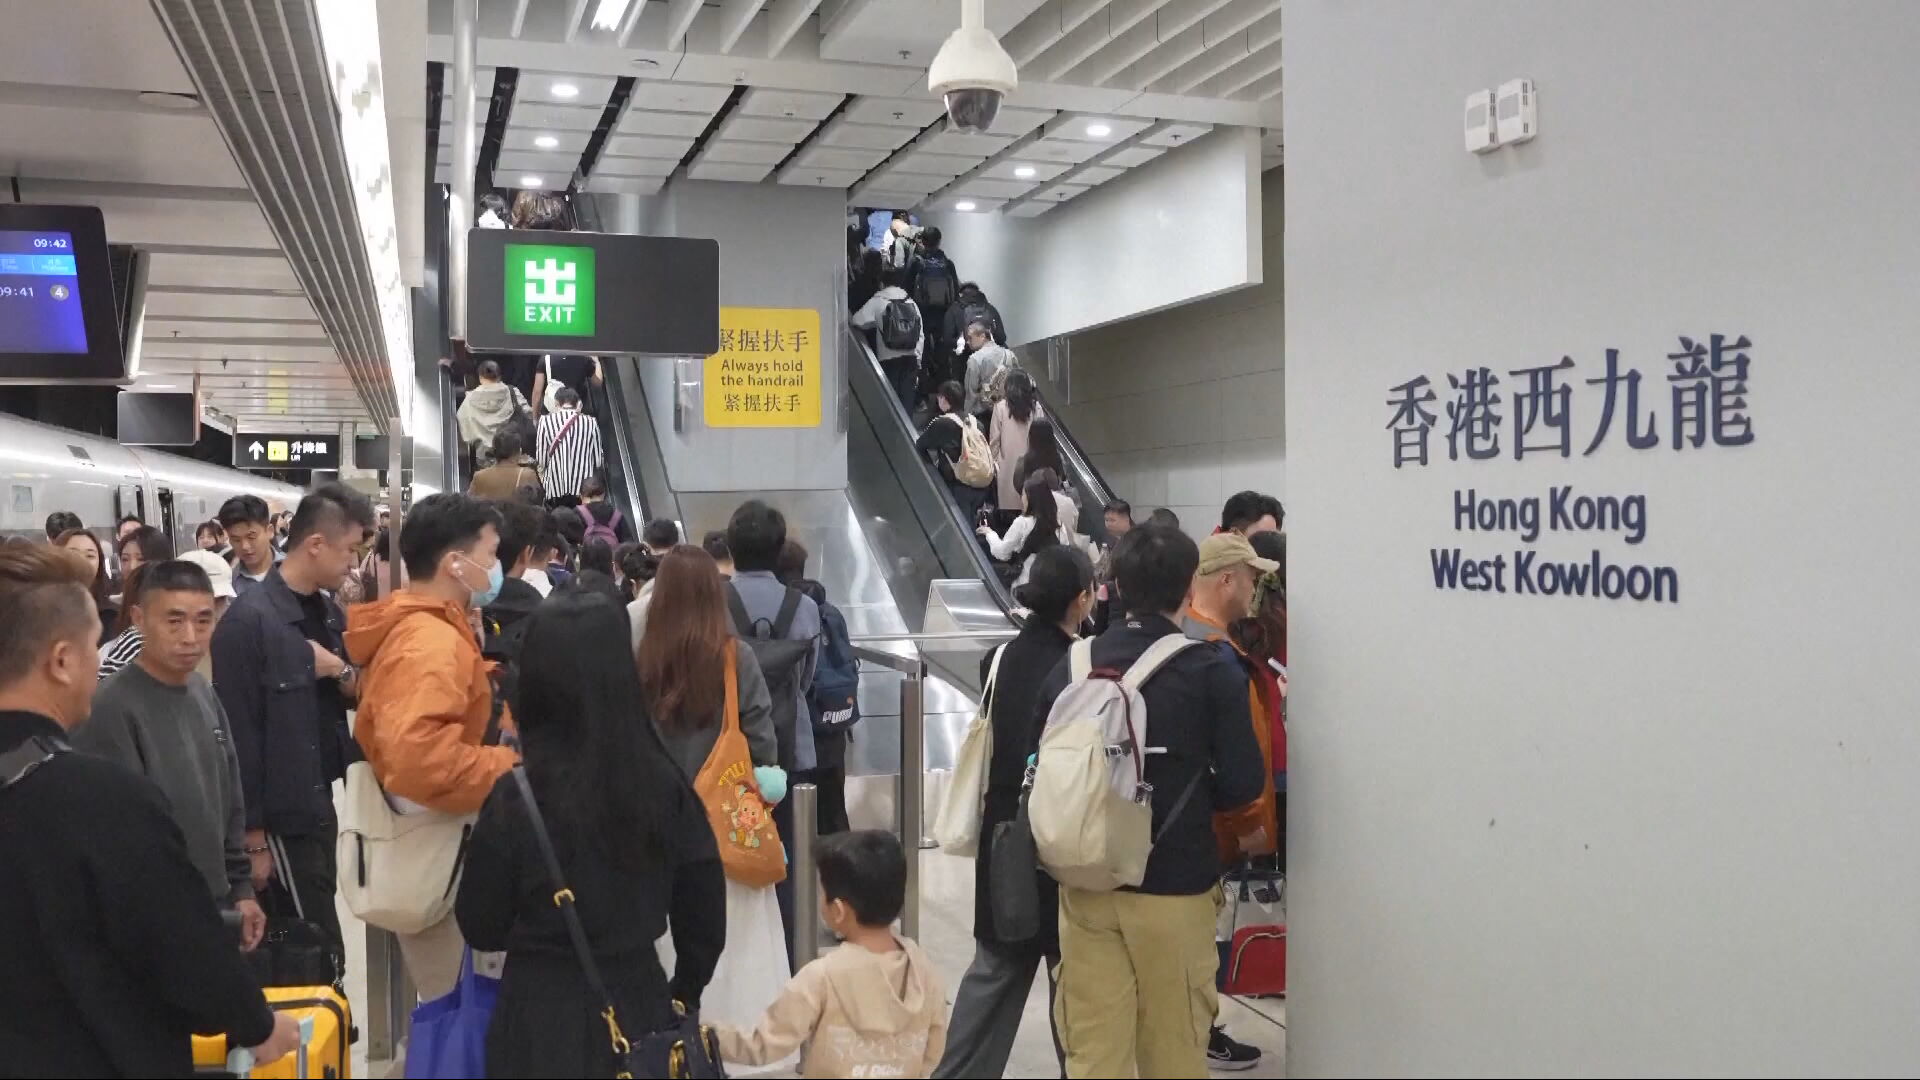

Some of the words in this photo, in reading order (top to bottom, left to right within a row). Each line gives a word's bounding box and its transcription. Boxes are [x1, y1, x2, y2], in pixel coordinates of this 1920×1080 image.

[34, 238, 67, 248] 09:42
[525, 259, 576, 305] 出
[55, 287, 64, 298] 4
[525, 306, 576, 324] EXIT
[721, 359, 769, 374] Always
[773, 360, 803, 372] hold
[721, 375, 744, 386] the
[748, 374, 804, 386] handrail
[1386, 333, 1755, 469] 香港西九龍
[1454, 489, 1540, 543] Hong
[1549, 486, 1646, 544] Kong
[1430, 549, 1506, 593] West
[1514, 550, 1679, 603] Kowloon
